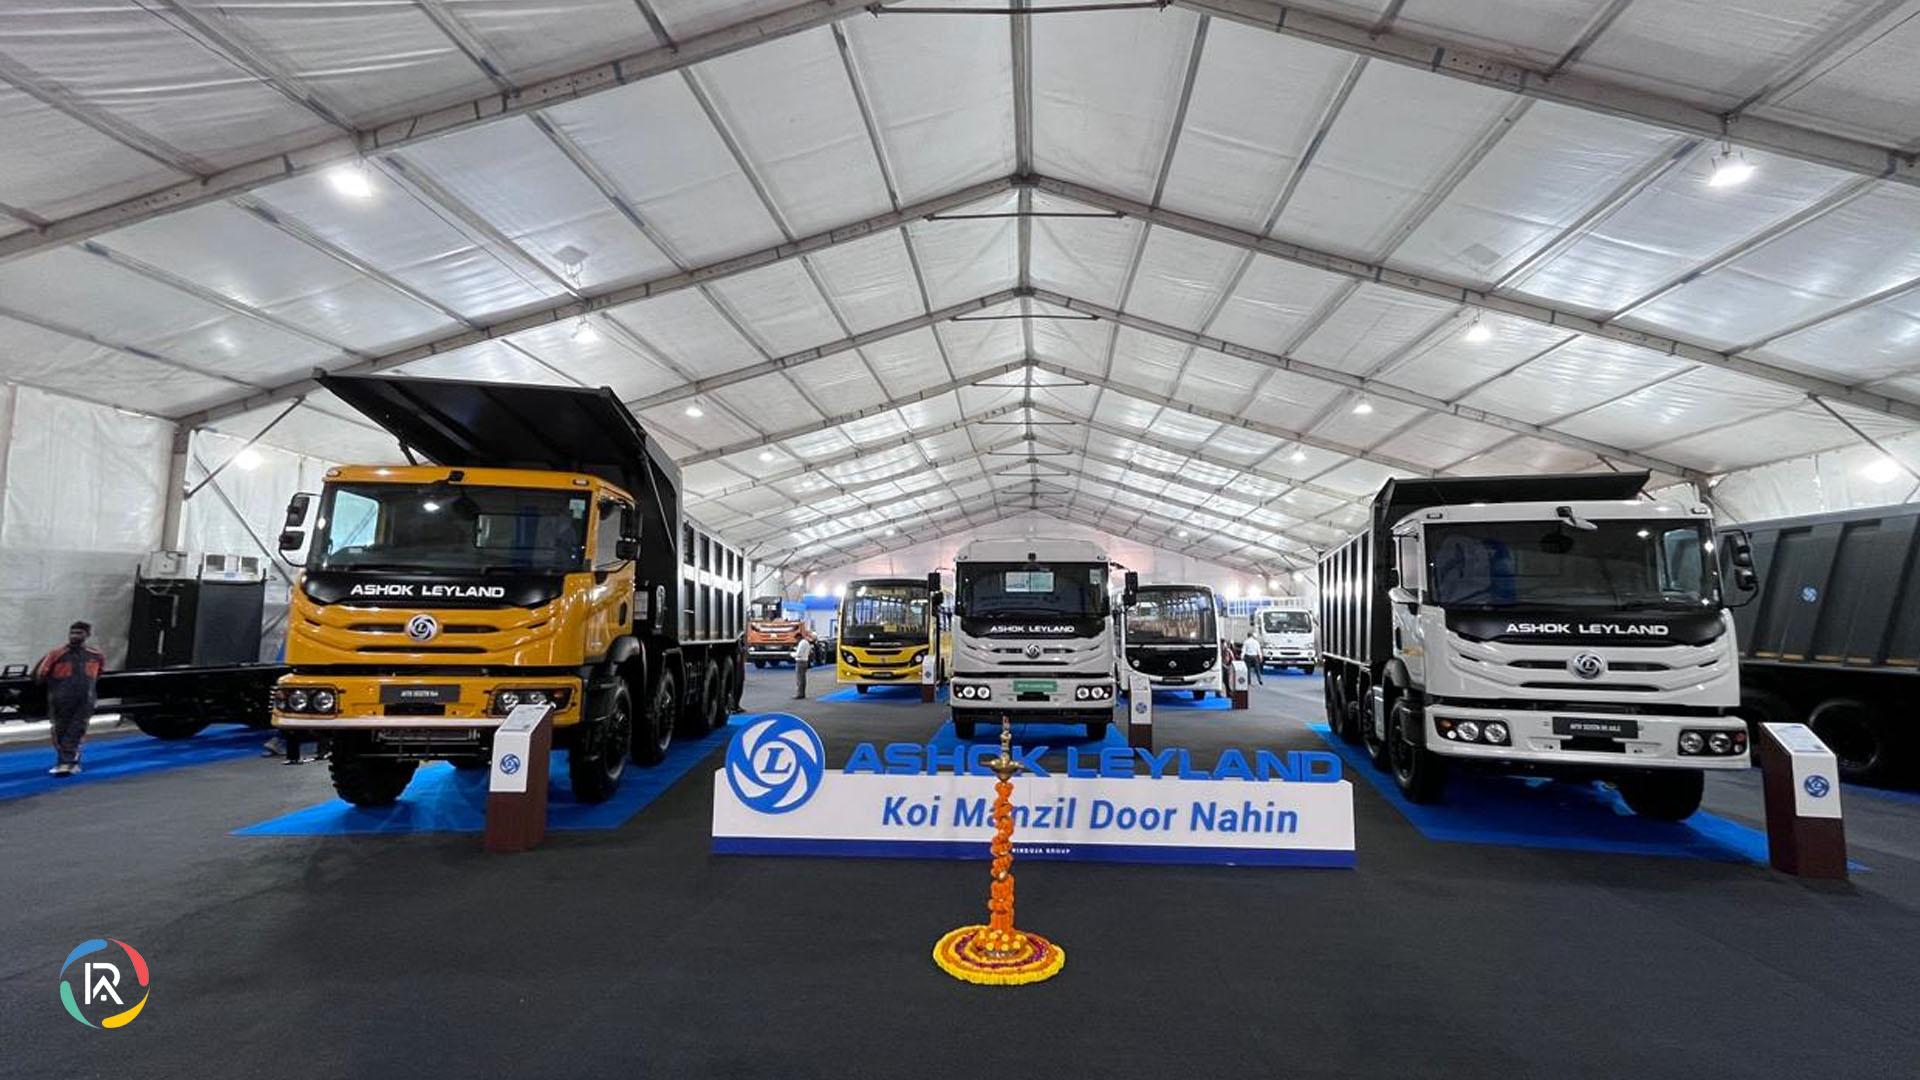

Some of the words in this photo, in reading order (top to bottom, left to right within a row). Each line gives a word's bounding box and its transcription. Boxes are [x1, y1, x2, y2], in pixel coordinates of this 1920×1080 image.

[351, 584, 414, 596] ASHOK
[422, 585, 505, 598] LEYLAND
[990, 625, 1025, 633] ASHOK
[1029, 625, 1075, 633] LEYLAND
[1506, 623, 1571, 634] ASHOK
[1579, 624, 1669, 636] LEYLAND
[761, 747, 791, 773] L
[843, 743, 1051, 777] ASHOK
[1067, 746, 1342, 783] LEYLAND
[882, 796, 941, 827] Koi
[953, 797, 1077, 829] Mnzil
[1089, 799, 1177, 831] Door
[1189, 802, 1298, 834] Nahin
